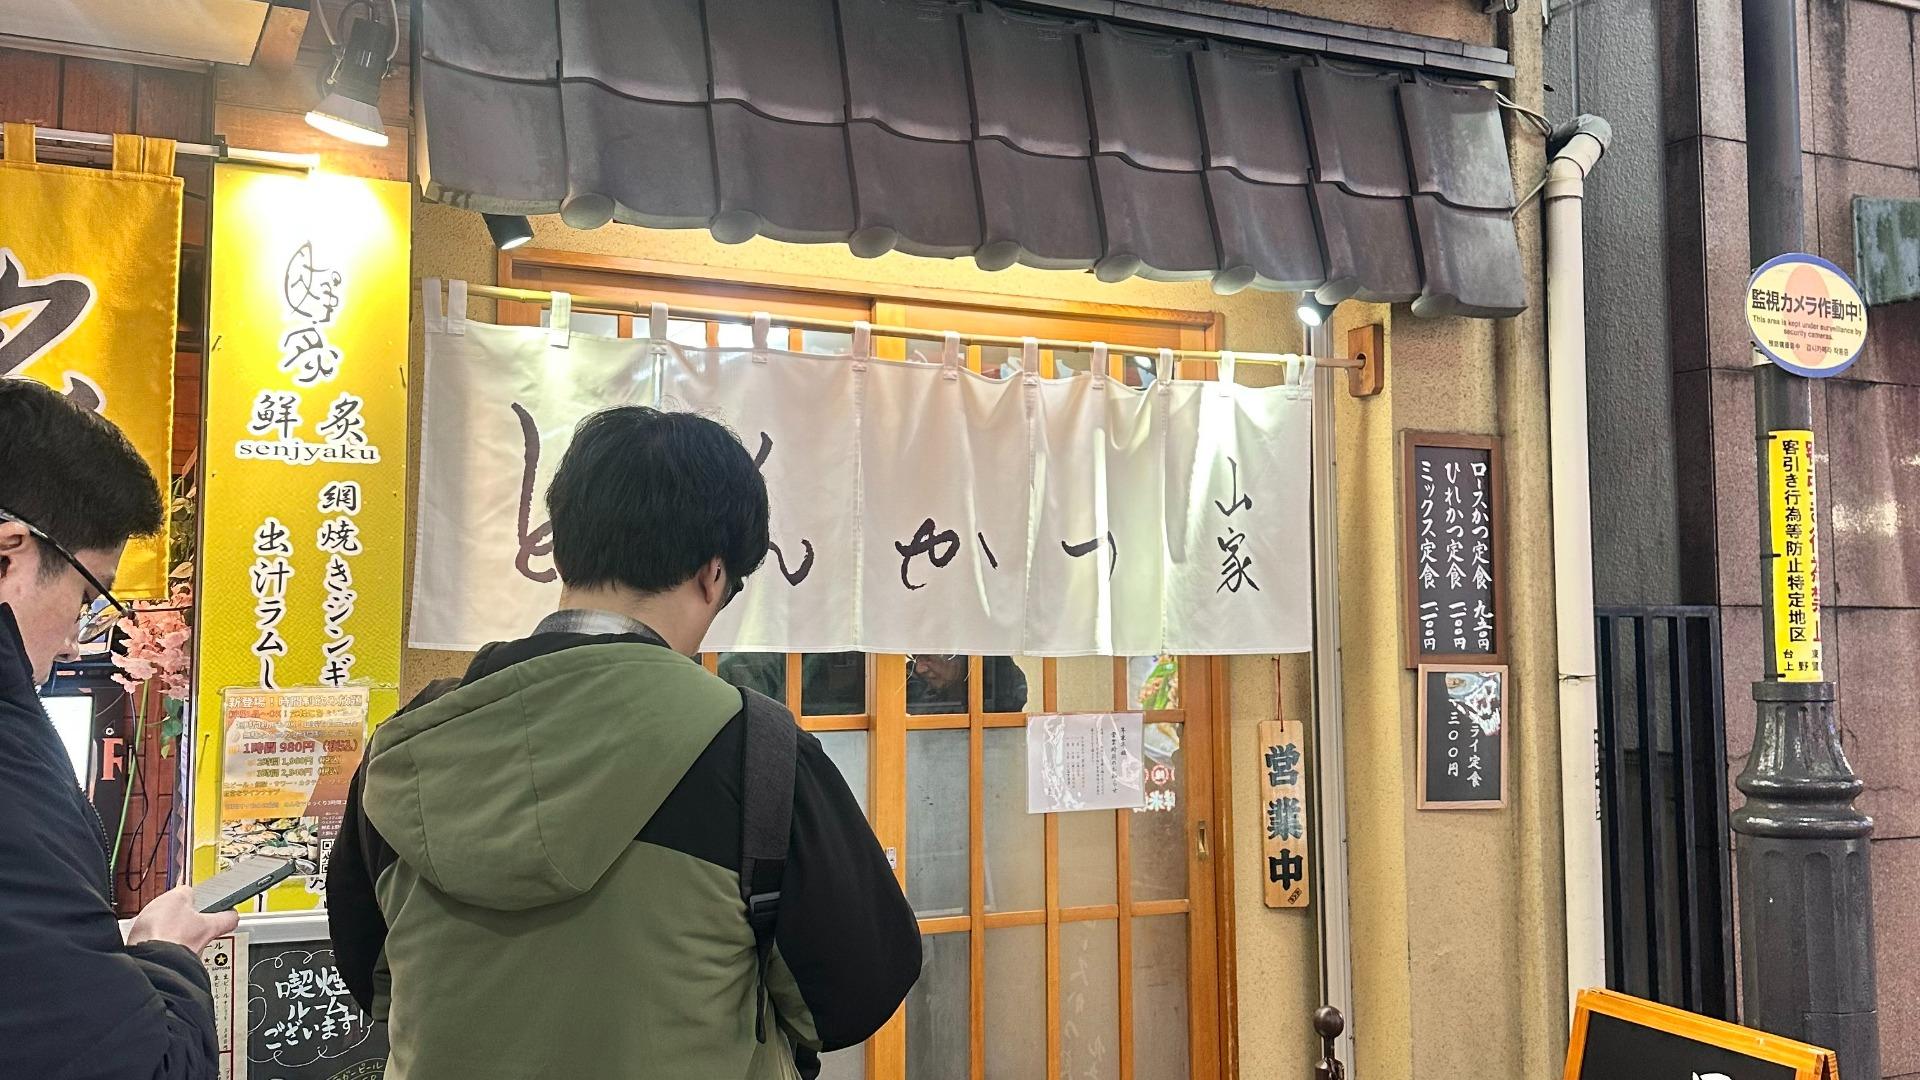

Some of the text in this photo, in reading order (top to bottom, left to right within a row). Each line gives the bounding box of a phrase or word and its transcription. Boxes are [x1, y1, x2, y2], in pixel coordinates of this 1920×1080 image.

[1753, 314, 1766, 323] This
[1767, 318, 1780, 326] area
[1788, 320, 1801, 328] kept
[1802, 322, 1819, 330] under
[1820, 325, 1854, 334] surveillance
[1855, 328, 1862, 336] by
[1783, 329, 1807, 338] security
[239, 441, 377, 461] senjyaku
[1215, 456, 1260, 594] 山家
[1419, 460, 1440, 589] ミックス定食
[1444, 462, 1467, 590] ひれかつ定食
[1470, 462, 1493, 590] ロースかつ定食
[1264, 743, 1303, 891] 営業中
[287, 996, 349, 1021] ルーム
